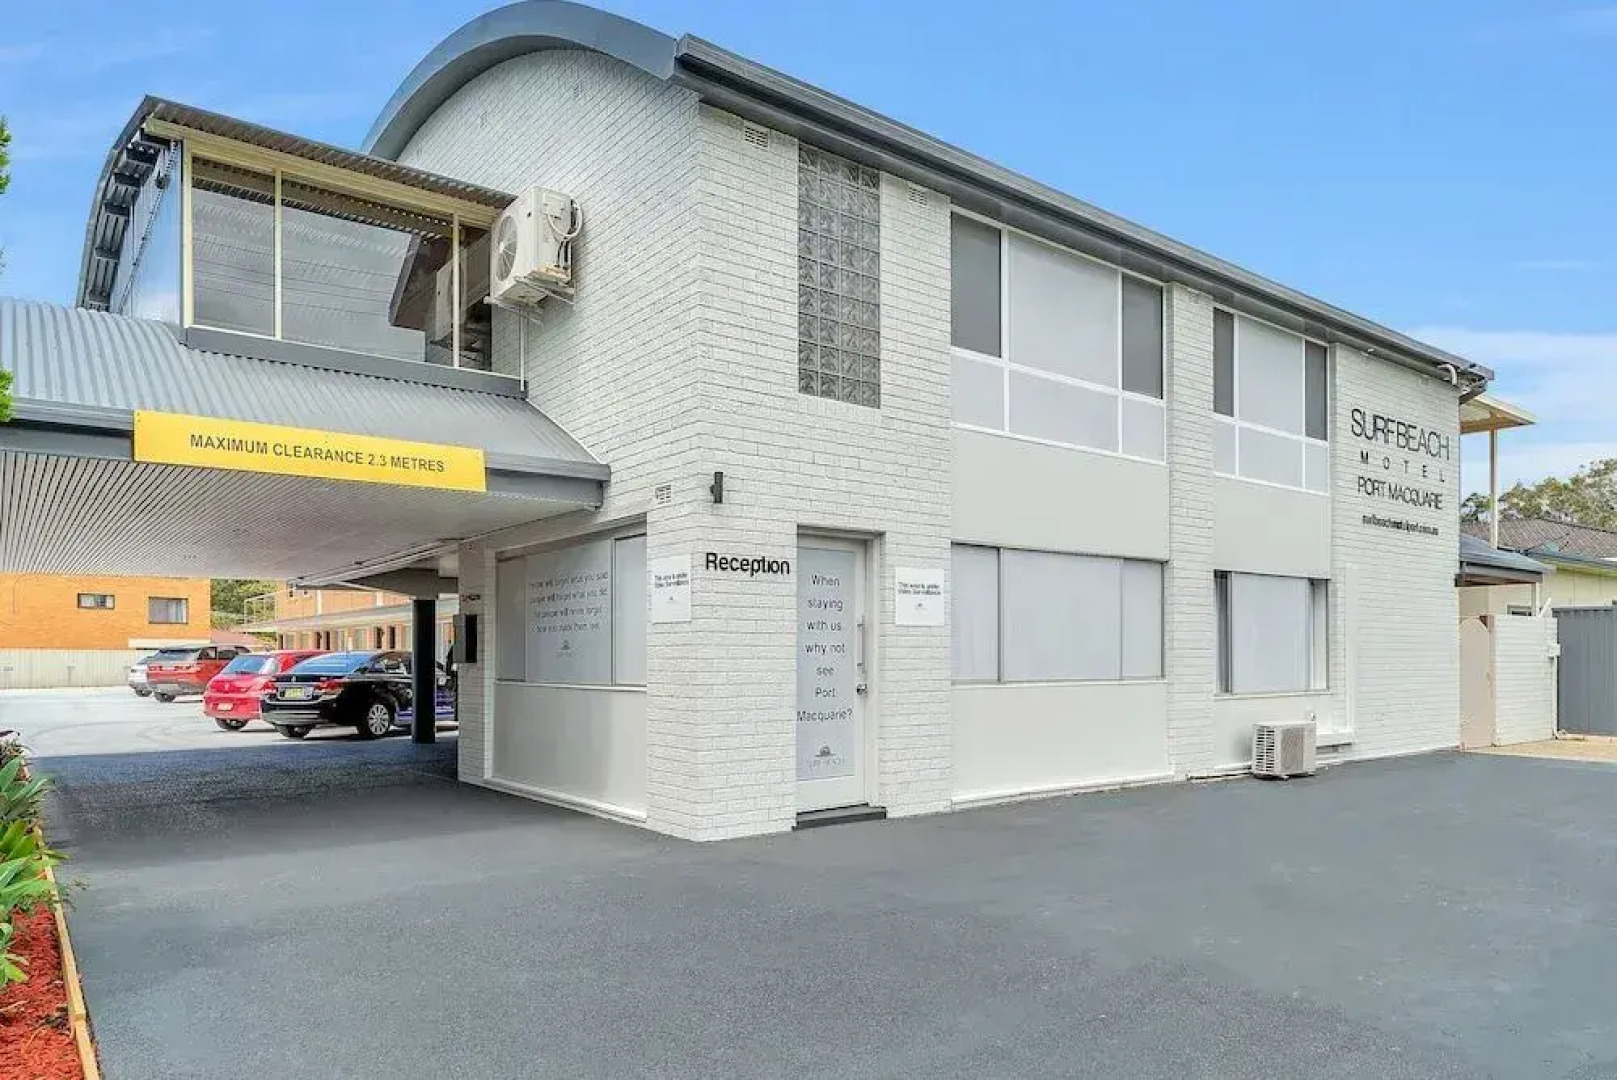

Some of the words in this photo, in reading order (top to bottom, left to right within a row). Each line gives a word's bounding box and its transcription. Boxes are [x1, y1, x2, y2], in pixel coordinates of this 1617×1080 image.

[190, 434, 268, 455] MAXIMUM
[272, 443, 363, 465] CLEARANCE
[368, 453, 387, 467] 2.3
[390, 456, 445, 473] METRES
[1357, 476, 1386, 499] PORT
[705, 552, 790, 577] Reception
[811, 573, 840, 587] When
[807, 598, 843, 611] staying
[806, 620, 829, 631] with
[830, 621, 842, 631] us
[804, 642, 827, 656] why
[830, 644, 846, 654] not
[816, 666, 835, 677] see
[815, 687, 836, 699] Port
[796, 708, 853, 723] Macquarie?
